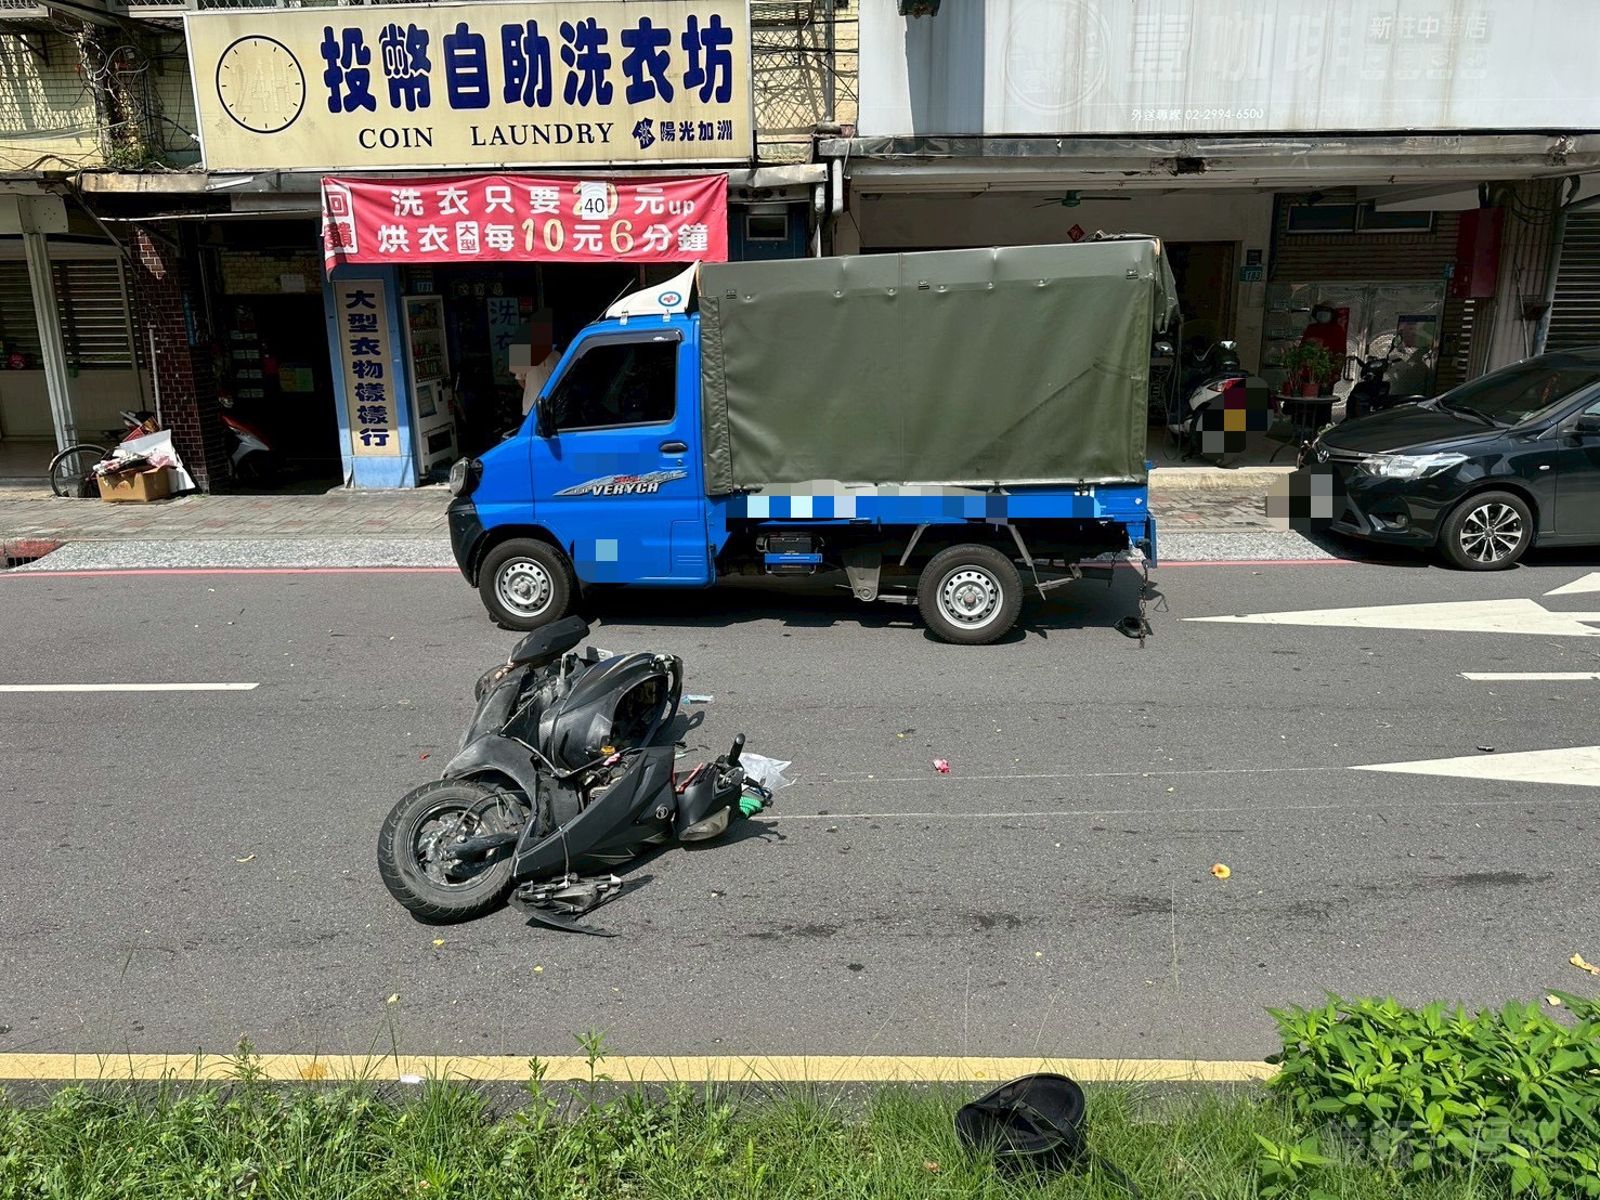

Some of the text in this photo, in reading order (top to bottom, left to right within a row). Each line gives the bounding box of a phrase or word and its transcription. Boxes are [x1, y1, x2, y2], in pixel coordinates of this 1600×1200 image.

[320, 13, 733, 114] 投幣自助洗衣坊
[358, 122, 614, 150] COIN LAUNDRY
[660, 119, 733, 143] 陽光加洲
[390, 184, 561, 217] 洗衣只要
[584, 197, 605, 214] 40
[345, 289, 390, 447] 大型衣物樣樣行
